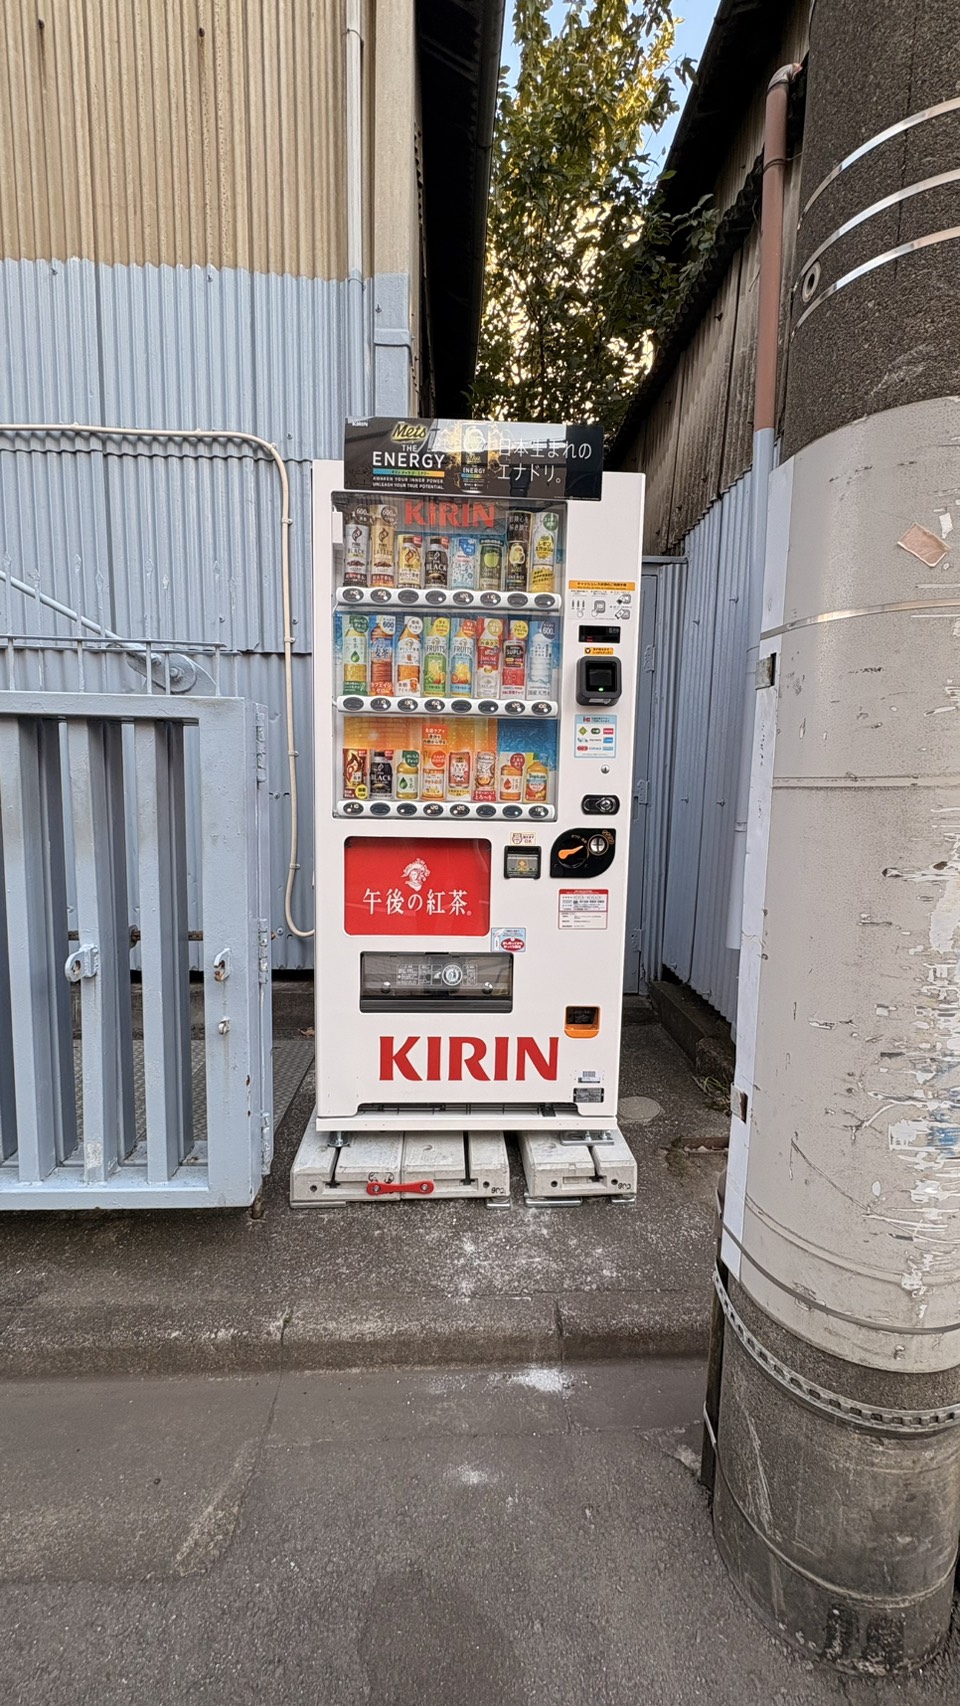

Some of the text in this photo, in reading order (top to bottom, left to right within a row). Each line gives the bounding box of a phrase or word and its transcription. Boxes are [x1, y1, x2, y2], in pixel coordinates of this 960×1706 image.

[392, 424, 427, 437] Mets
[499, 438, 592, 459] 日本生まれの
[373, 452, 445, 469] ENERGY
[498, 463, 561, 483] エナドリ。
[405, 500, 495, 528] KIRIN
[453, 646, 473, 654] FRUITS
[362, 888, 468, 916] 午後の紅茶
[379, 1036, 559, 1081] KIRIN
